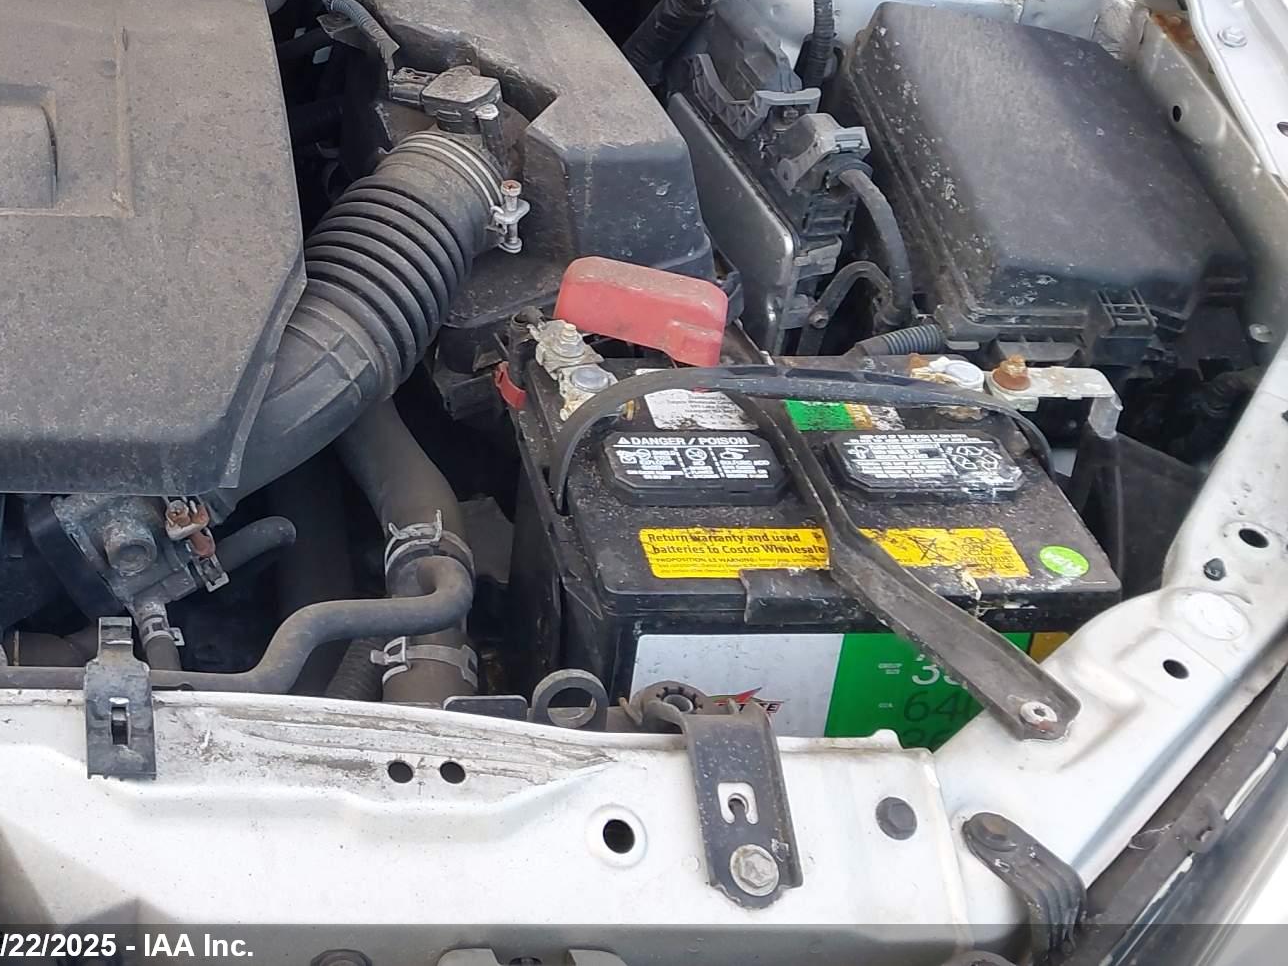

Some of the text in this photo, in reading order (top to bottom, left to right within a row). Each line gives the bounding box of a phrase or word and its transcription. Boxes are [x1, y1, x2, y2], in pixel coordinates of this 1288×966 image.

[630, 437, 686, 445] DANGER
[698, 437, 749, 445] POISON
[648, 533, 801, 545] Return warranty and used
[653, 545, 825, 554] batteries to Costco Wholesale
